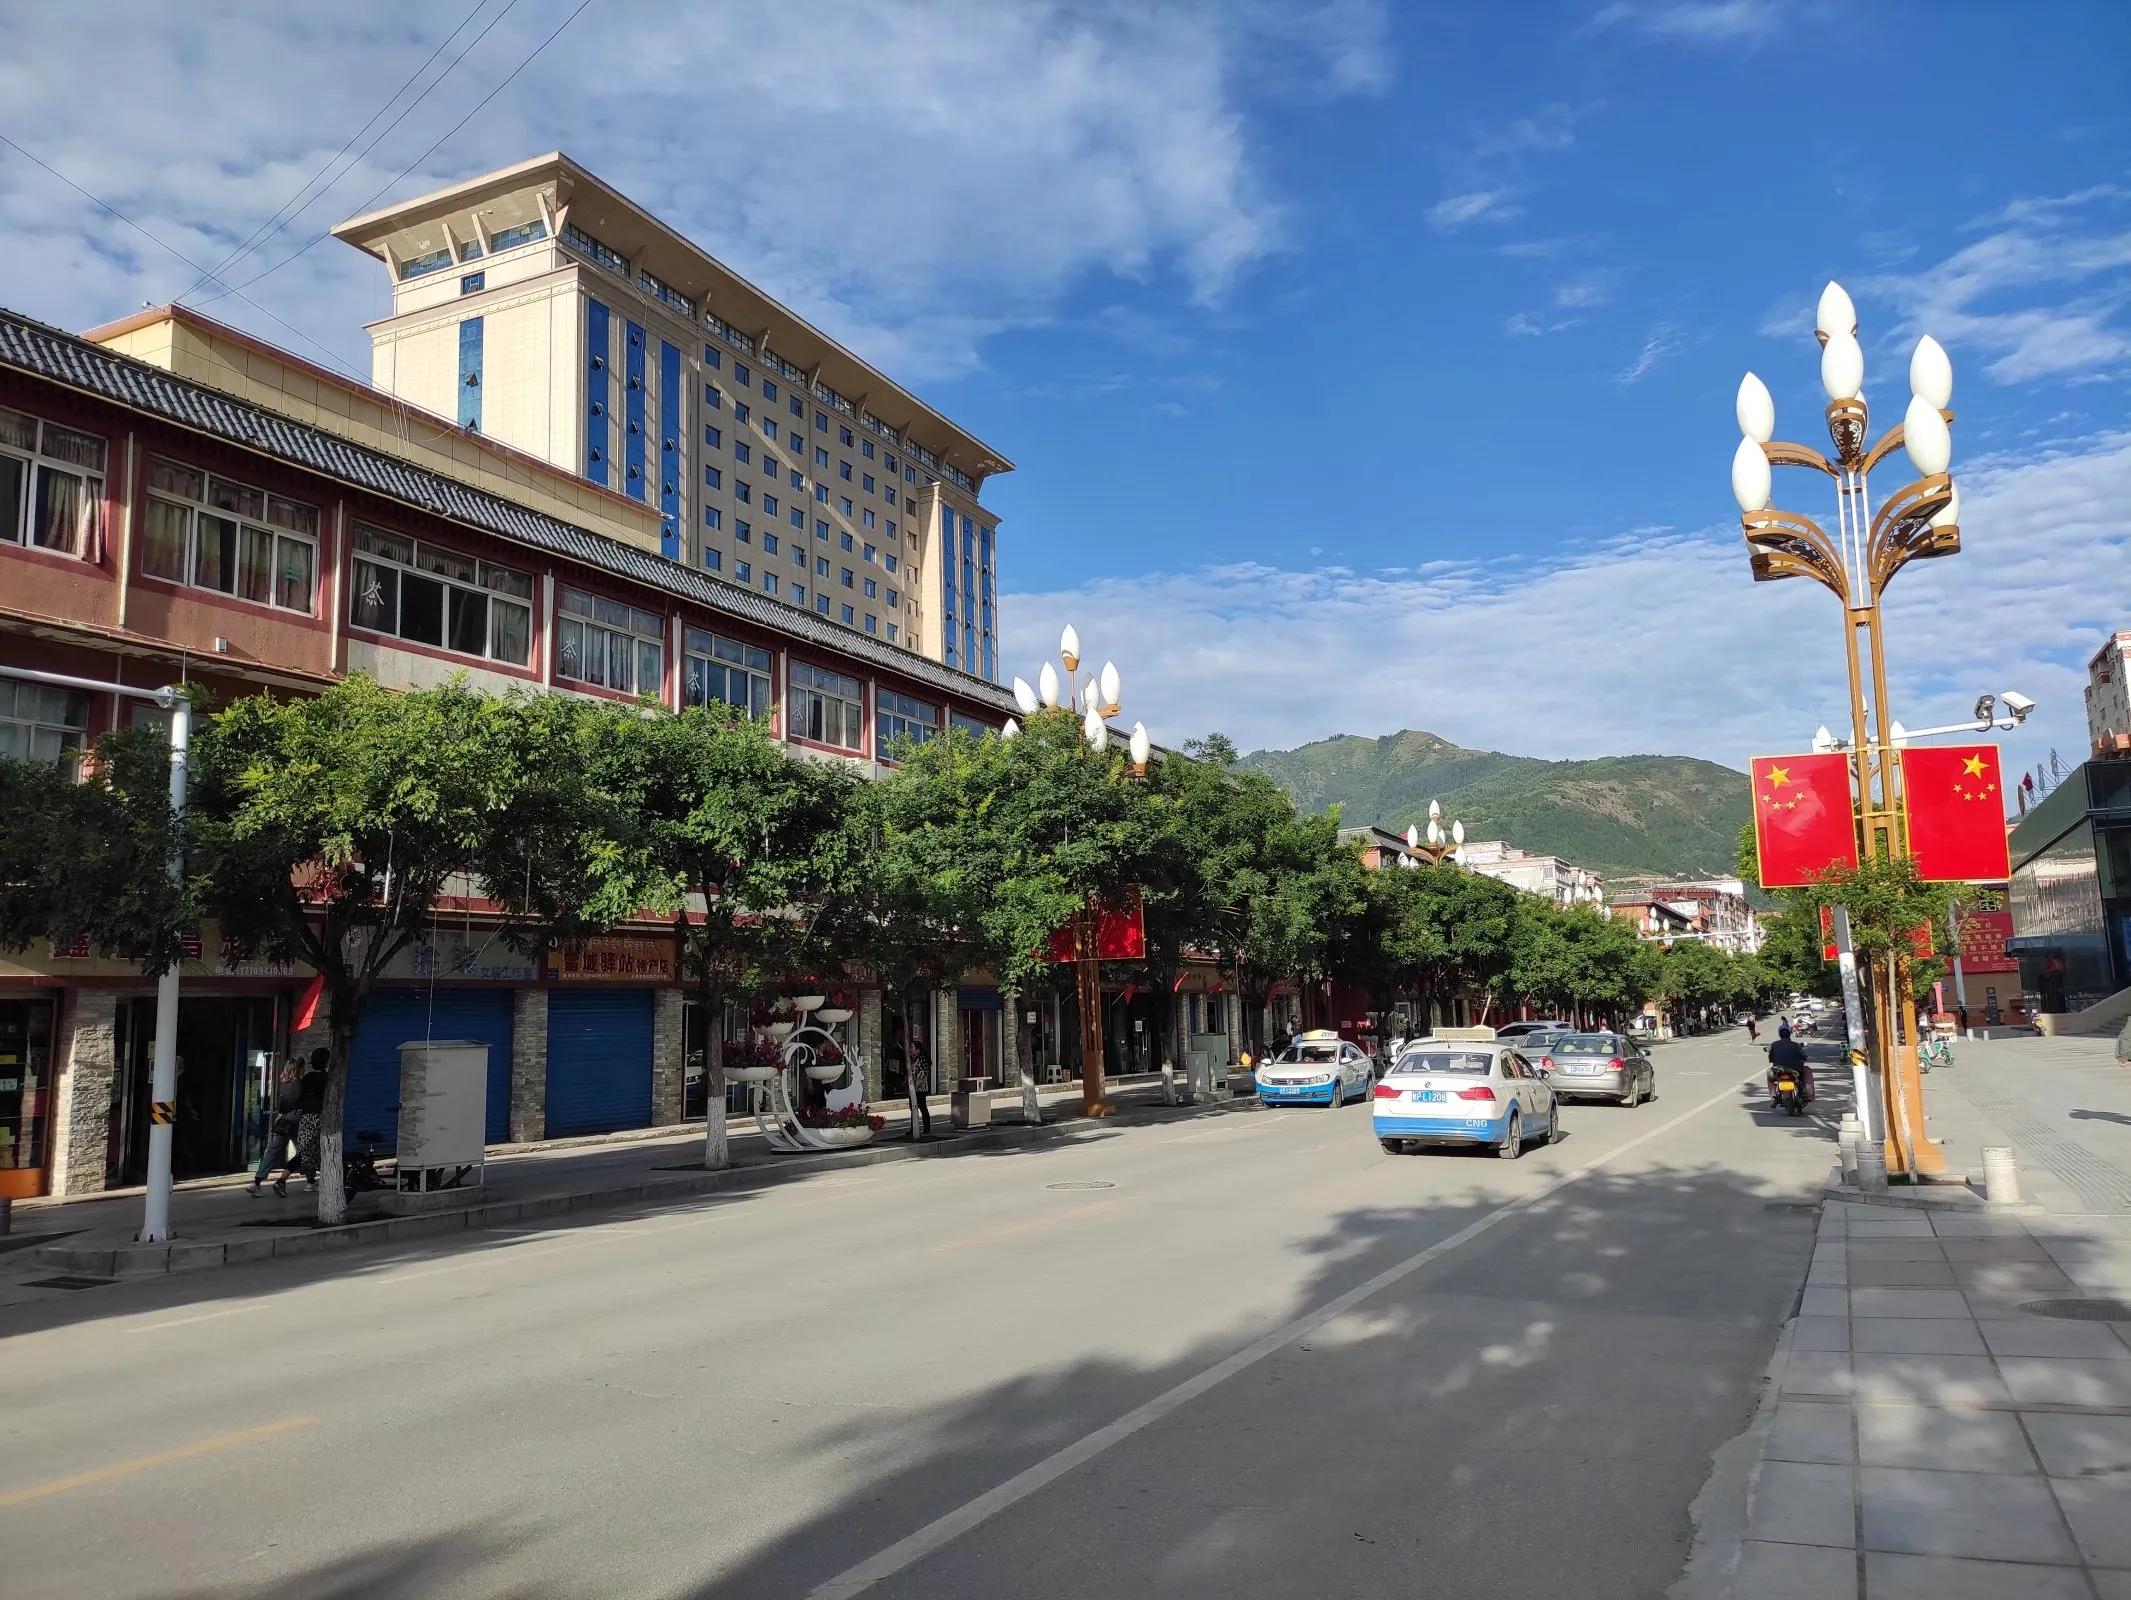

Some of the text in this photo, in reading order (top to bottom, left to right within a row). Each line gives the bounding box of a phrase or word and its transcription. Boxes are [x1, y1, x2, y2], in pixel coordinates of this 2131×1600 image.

[360, 580, 386, 608] 茶
[561, 636, 577, 660] 茶
[687, 670, 702, 692] 茶
[1466, 1119, 1488, 1128] CNG
